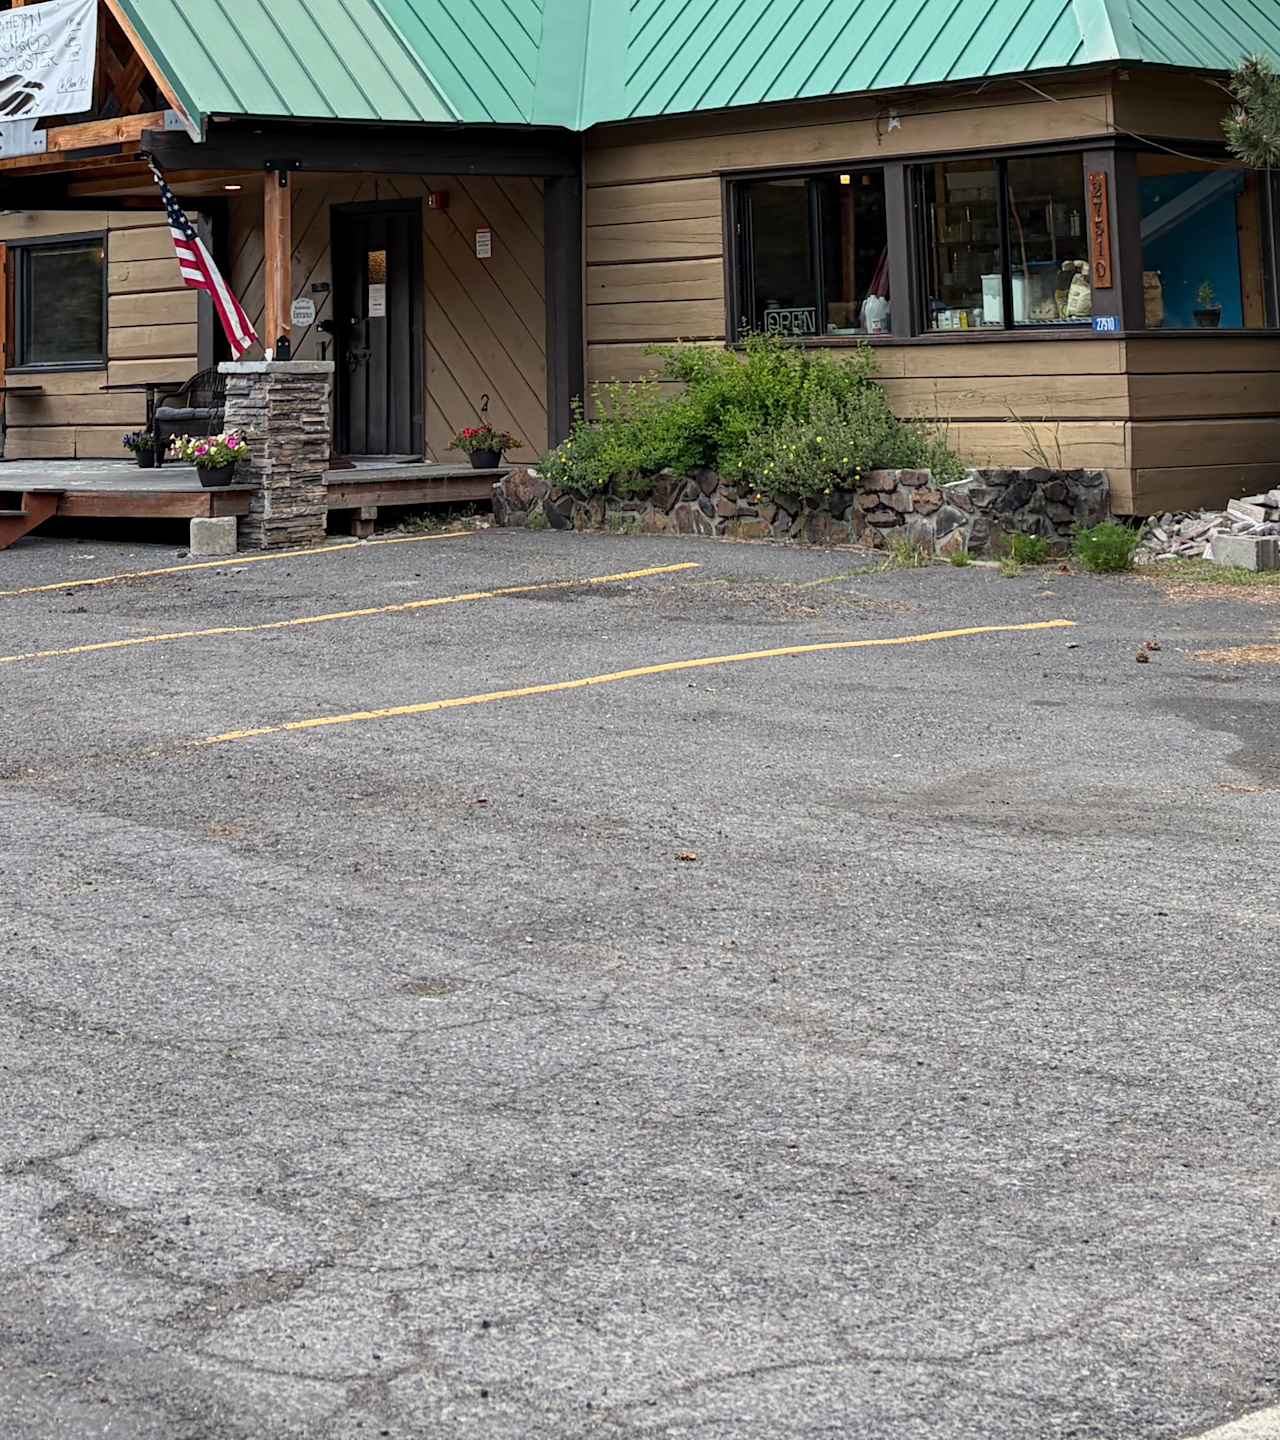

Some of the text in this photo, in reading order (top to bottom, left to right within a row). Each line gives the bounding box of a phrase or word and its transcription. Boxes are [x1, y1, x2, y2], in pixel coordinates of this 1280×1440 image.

[1092, 182, 1106, 278] 27510
[768, 312, 816, 333] OPEN
[1096, 318, 1115, 331] 27510
